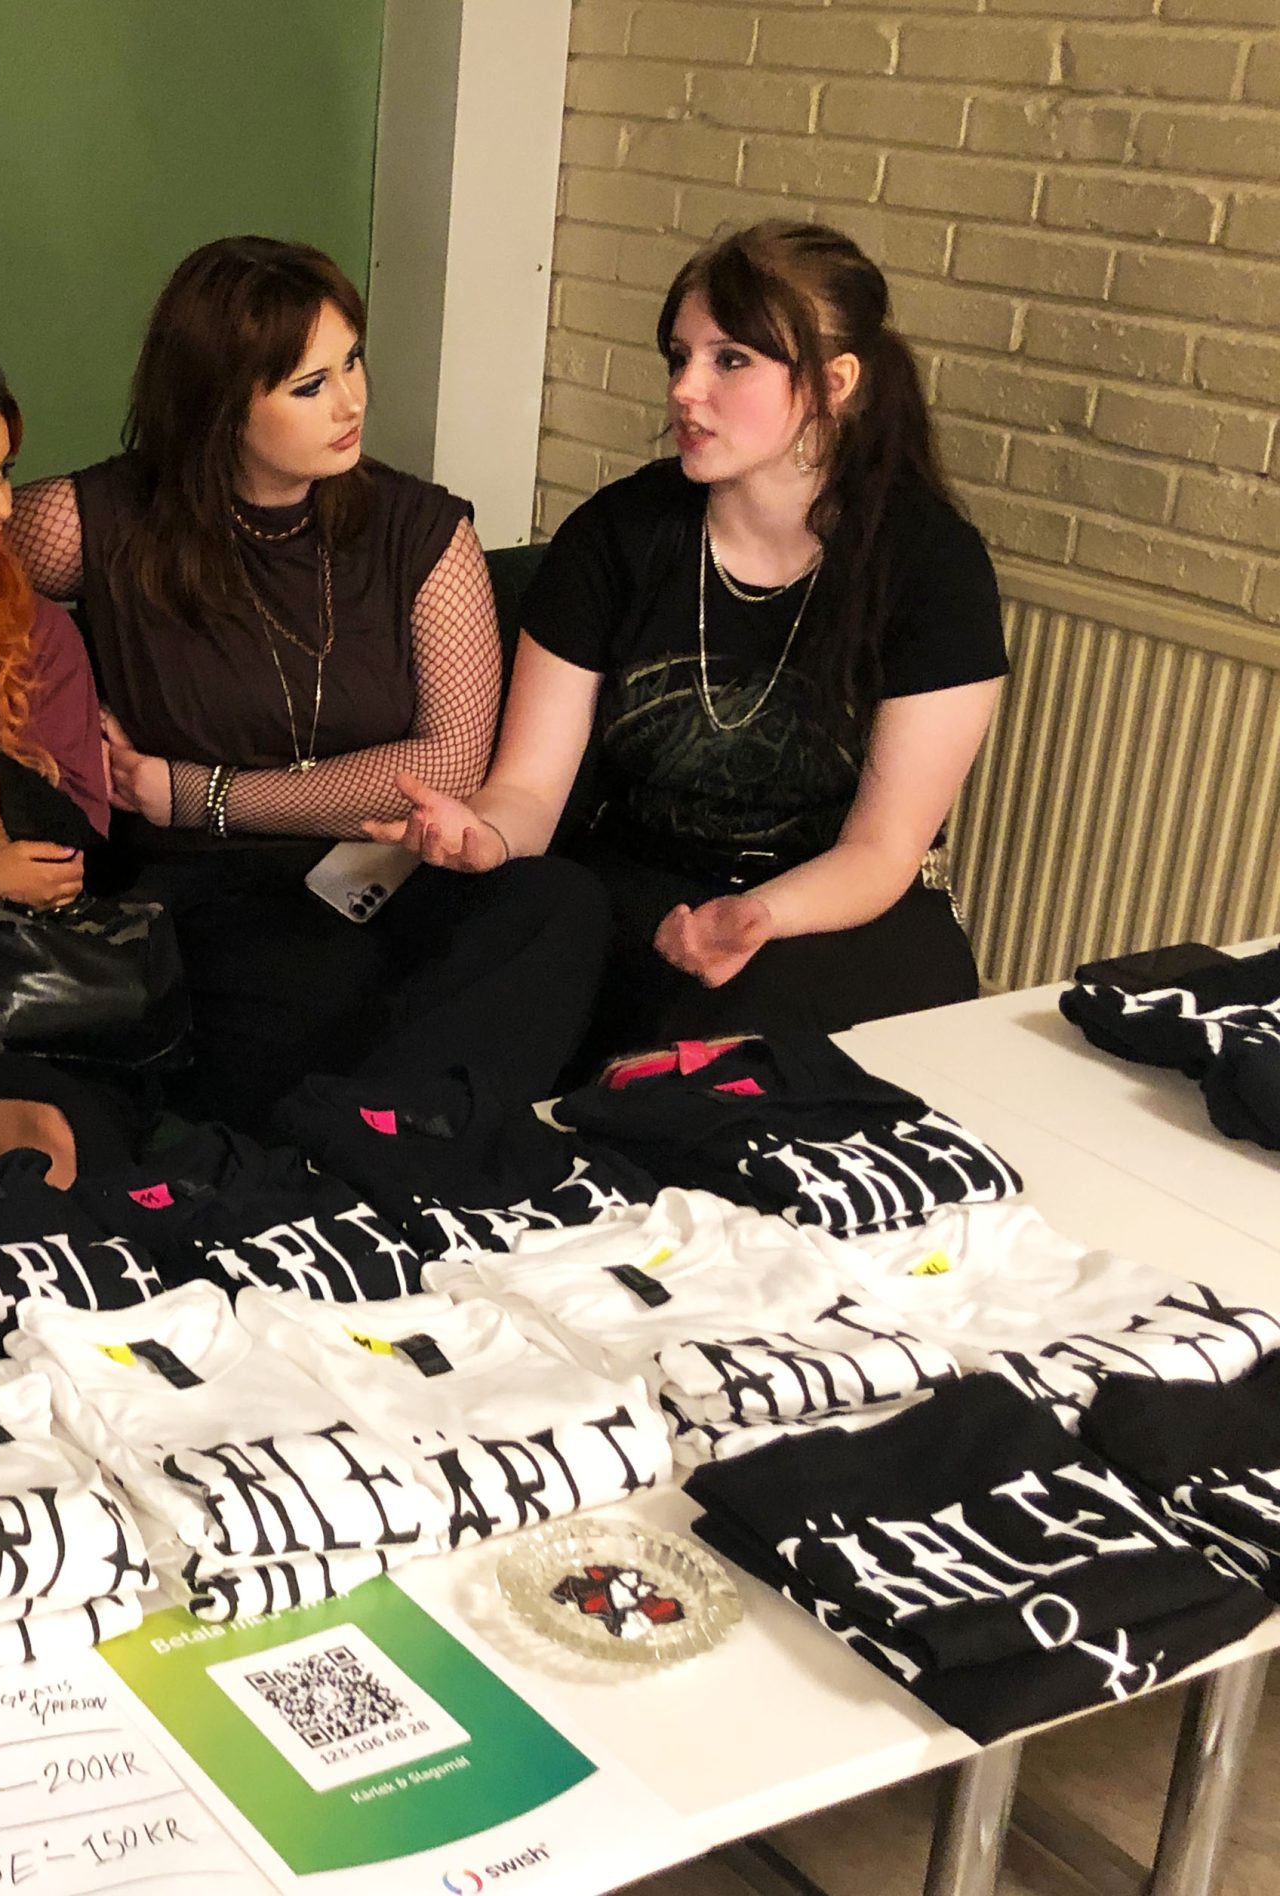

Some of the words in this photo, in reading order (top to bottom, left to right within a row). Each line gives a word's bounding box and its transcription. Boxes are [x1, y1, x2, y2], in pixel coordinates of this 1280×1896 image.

[150, 1623, 226, 1655] Betala
[0, 1679, 73, 1709] GRATIS
[485, 1846, 550, 1878] swish
